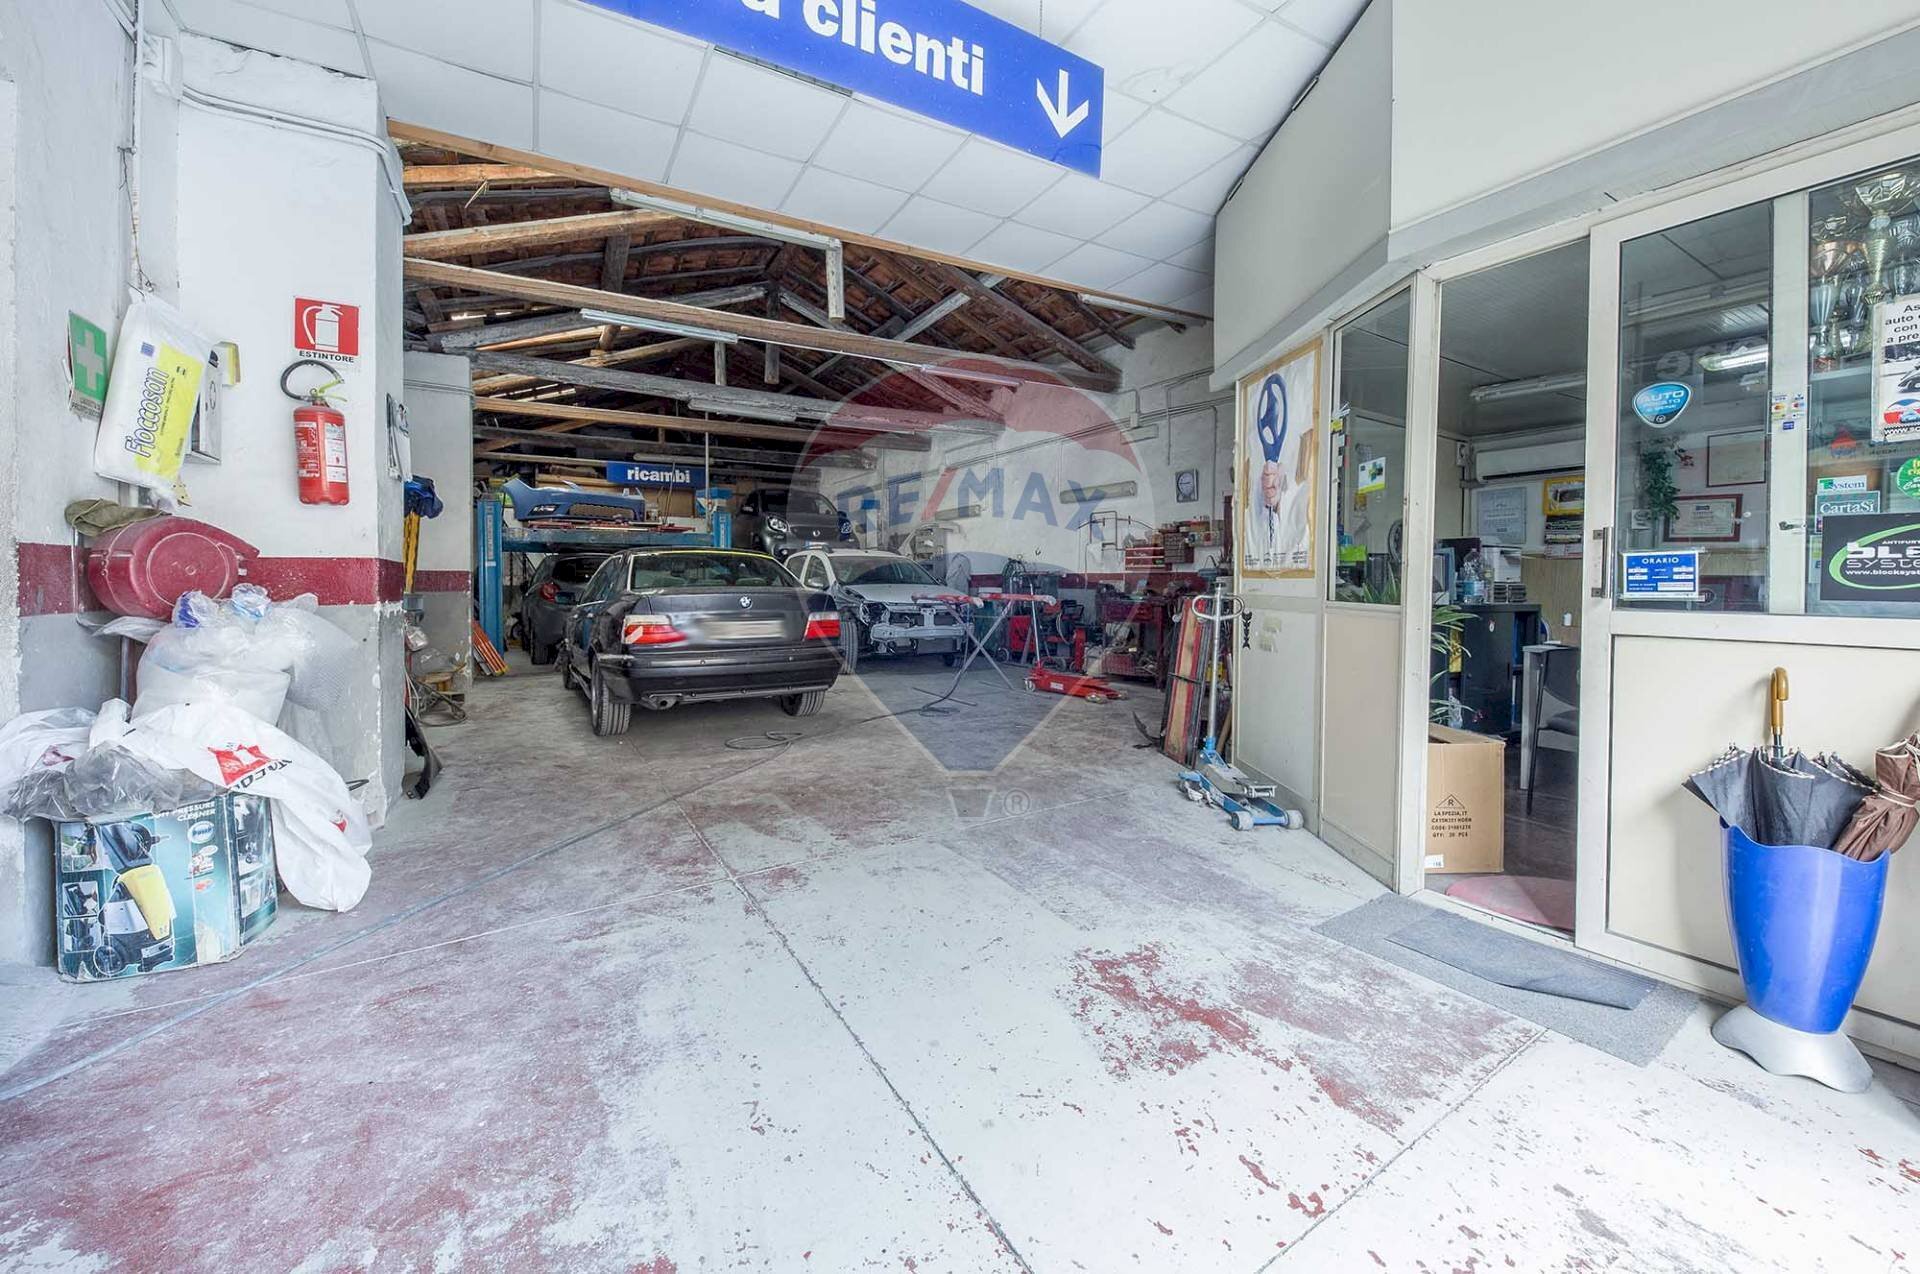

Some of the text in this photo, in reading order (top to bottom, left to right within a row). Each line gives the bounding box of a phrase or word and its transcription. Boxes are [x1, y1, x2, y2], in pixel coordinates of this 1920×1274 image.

[803, 0, 983, 96] clienti
[1885, 315, 1914, 325] auto
[1894, 323, 1918, 333] con
[299, 350, 354, 363] ESTINTORE
[125, 367, 170, 458] Fioccosan
[627, 467, 690, 483] ricambi
